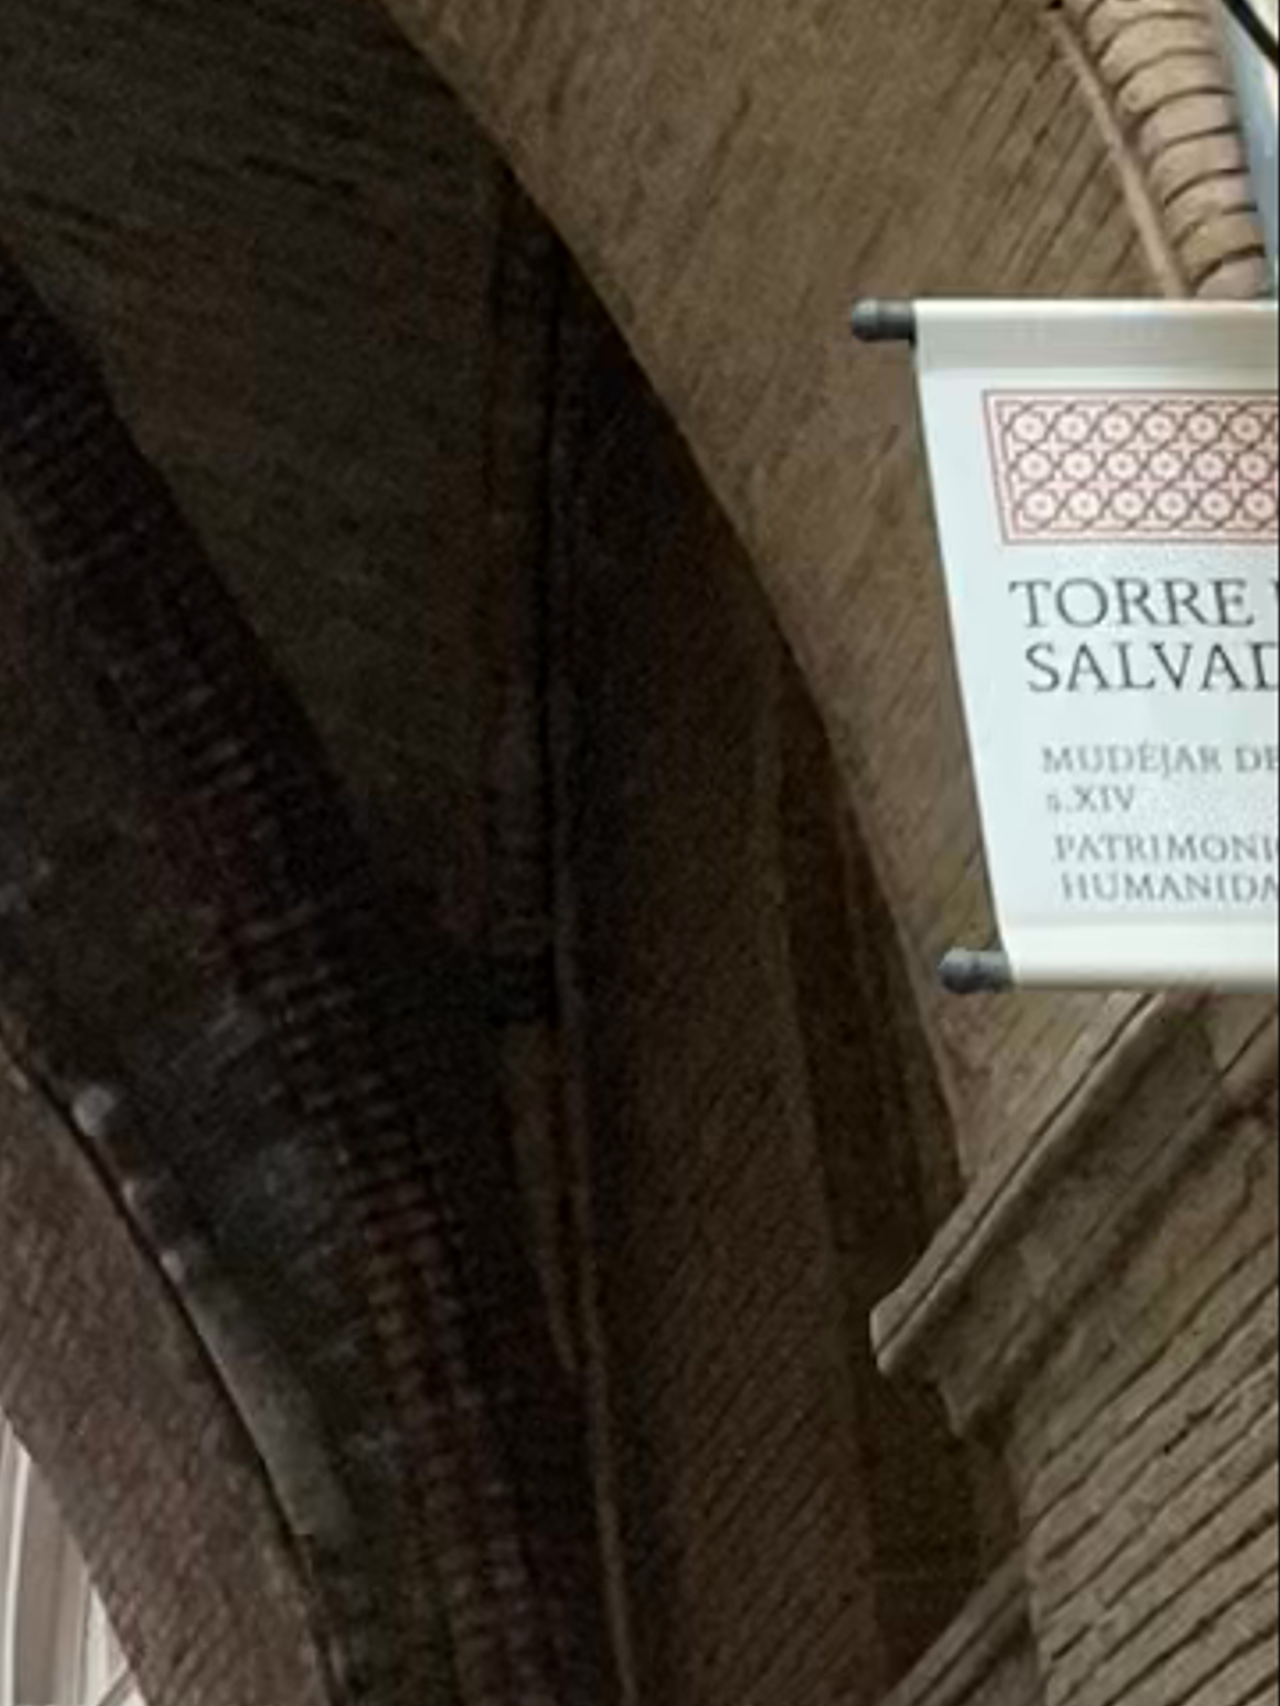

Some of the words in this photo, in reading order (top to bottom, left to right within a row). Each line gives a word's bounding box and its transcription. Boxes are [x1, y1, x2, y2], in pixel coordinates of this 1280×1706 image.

[1008, 576, 1255, 628] TORRE
[1042, 739, 1223, 779] MUDÉJAR
[1053, 833, 1279, 863] PATRIMONI
